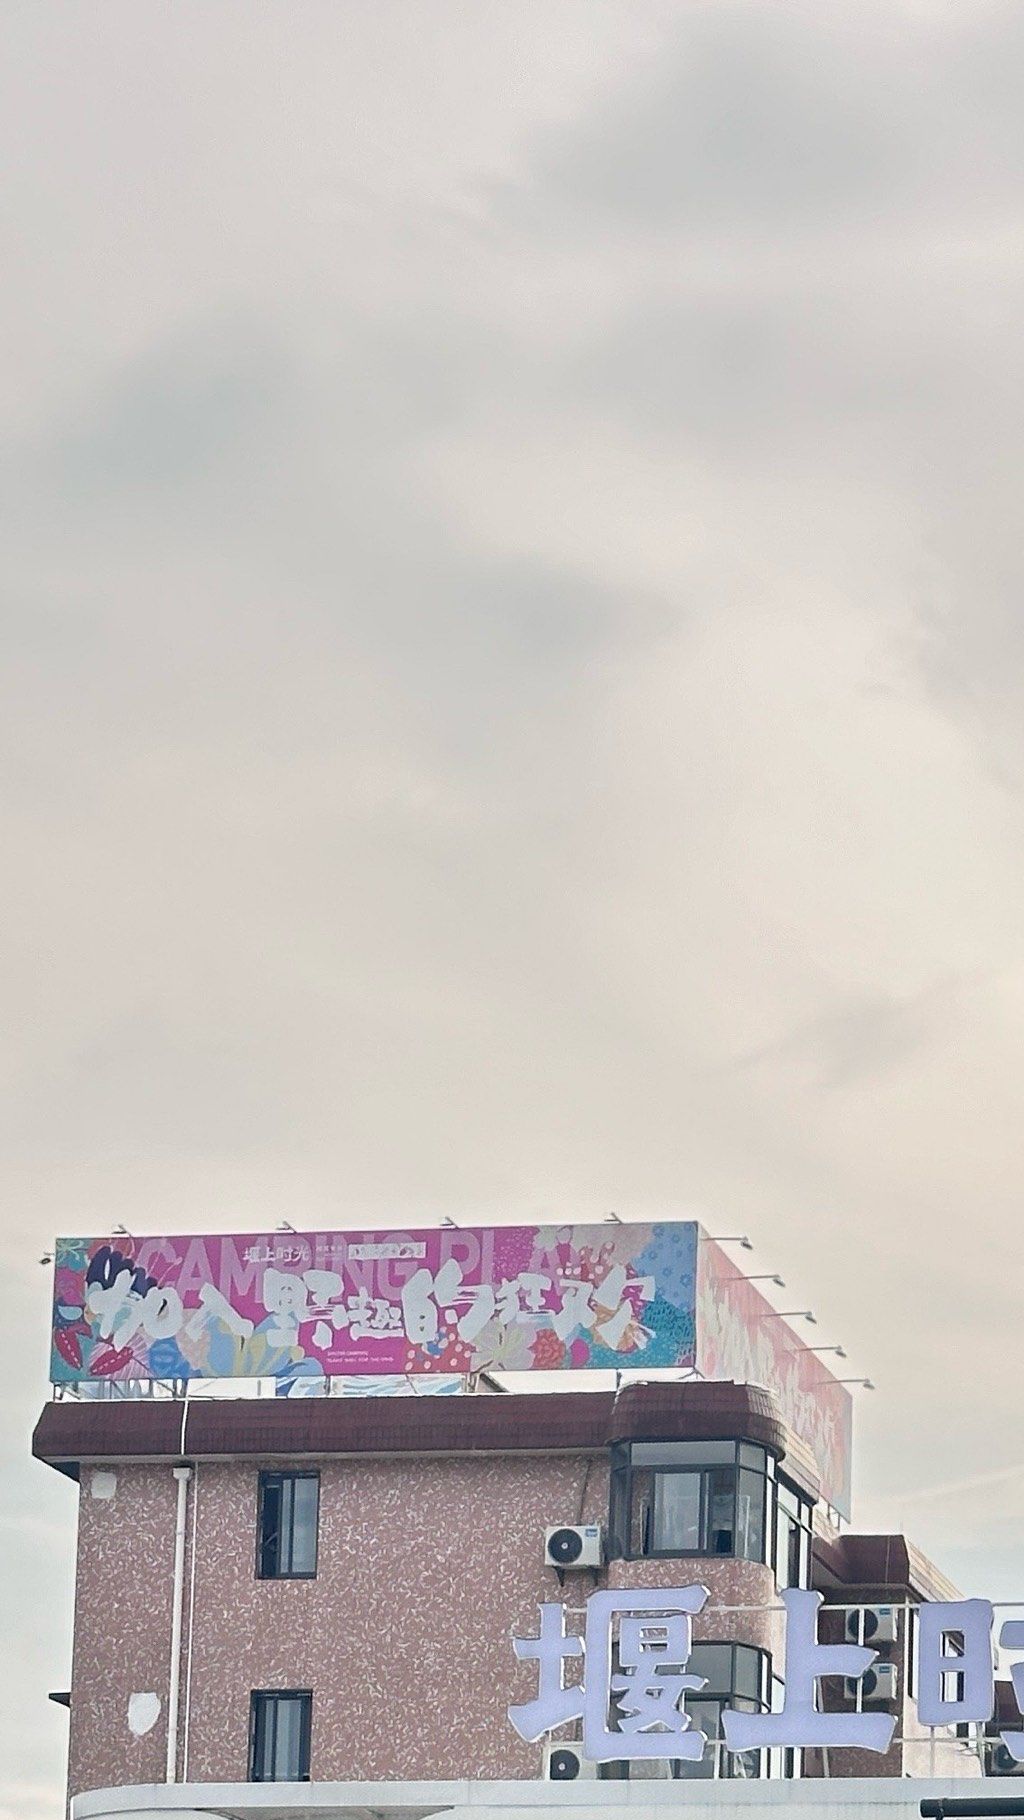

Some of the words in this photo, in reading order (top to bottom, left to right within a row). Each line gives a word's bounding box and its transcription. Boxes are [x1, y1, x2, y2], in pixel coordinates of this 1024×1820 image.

[84, 1257, 657, 1352] 加入野趣的狂欢
